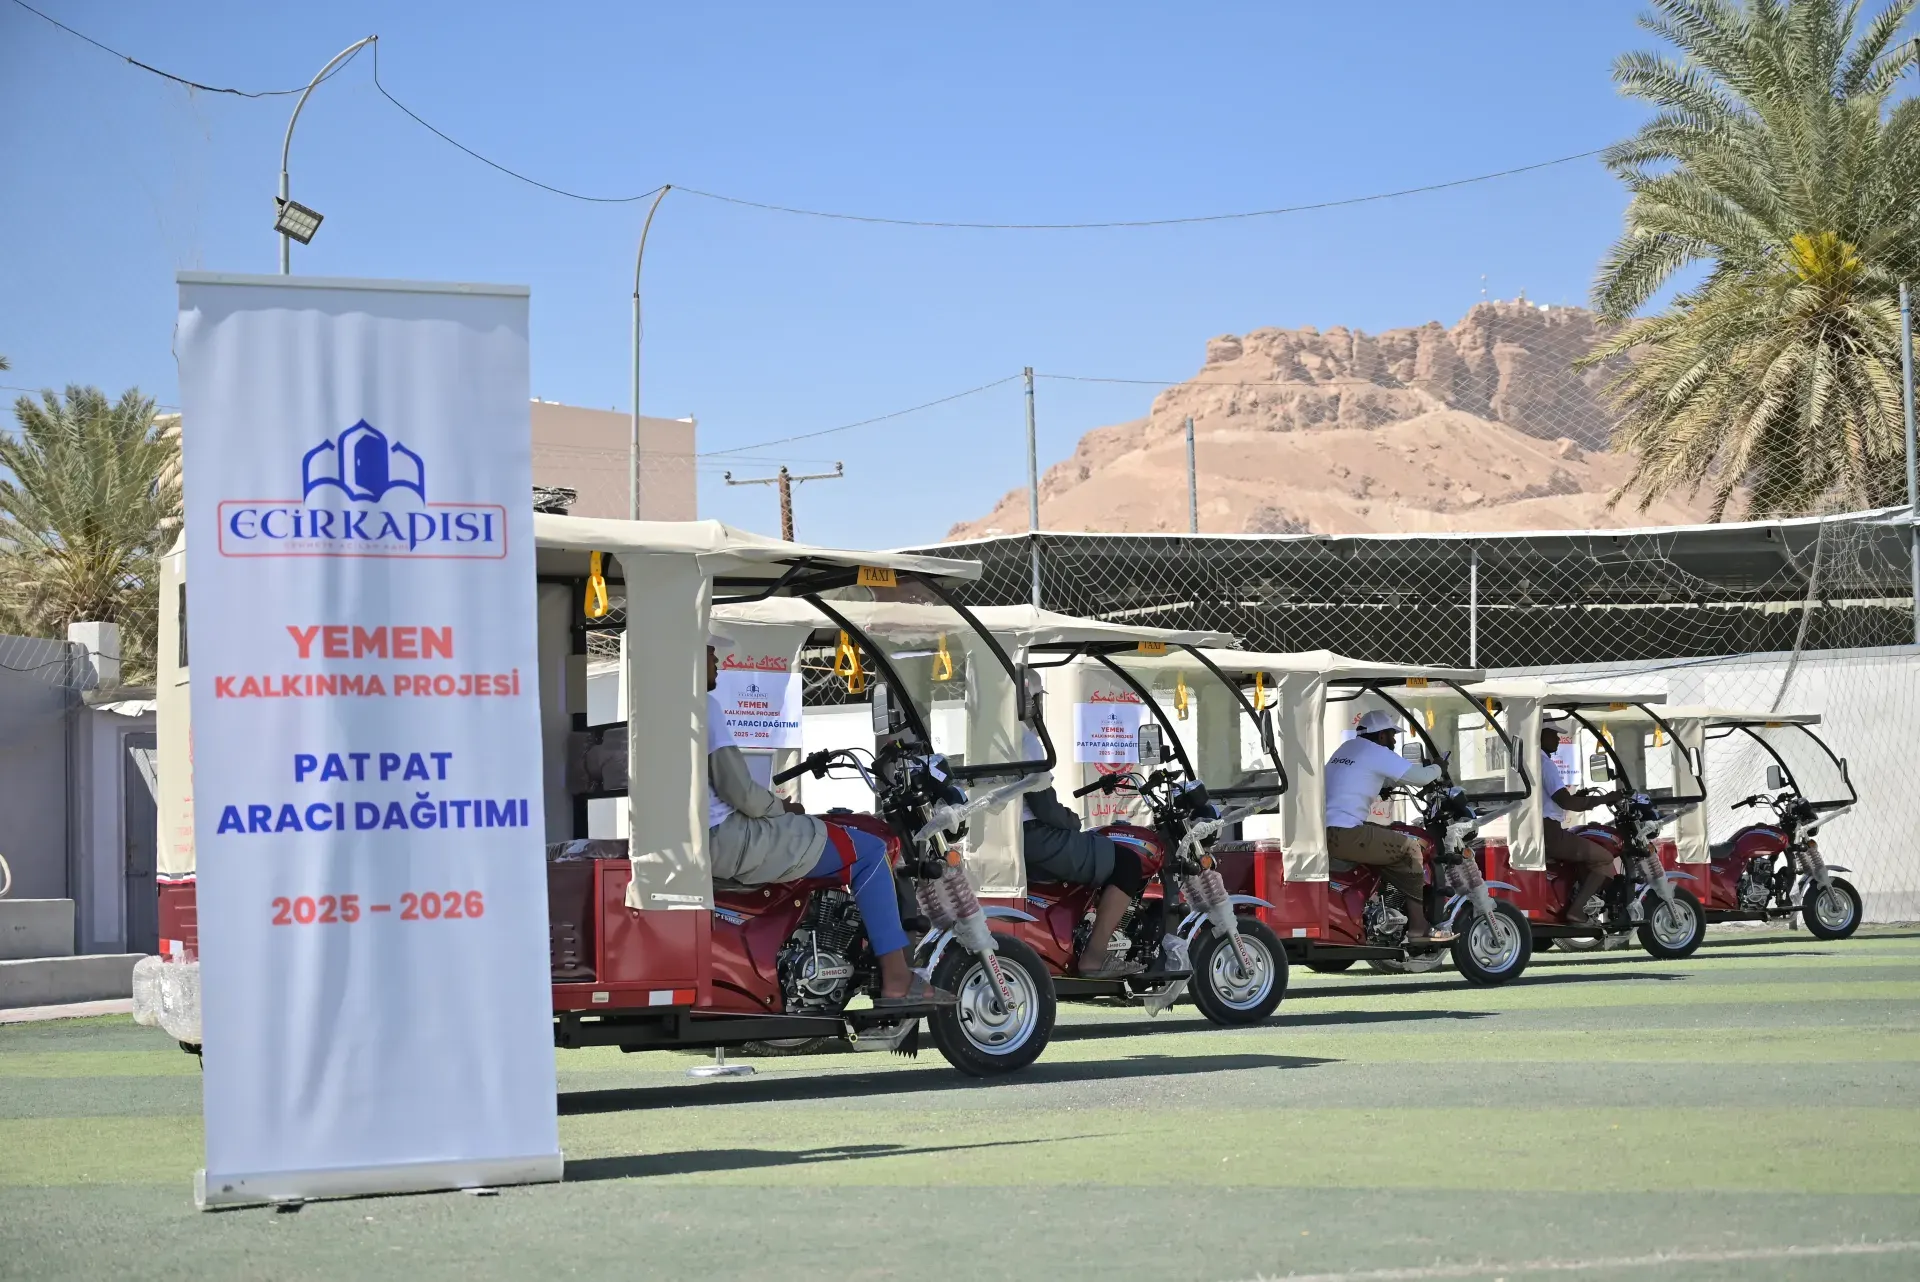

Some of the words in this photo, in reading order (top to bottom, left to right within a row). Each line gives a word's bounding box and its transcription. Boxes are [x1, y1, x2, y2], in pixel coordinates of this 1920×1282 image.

[863, 568, 889, 582] TAXI
[286, 625, 454, 660] YEMEN
[215, 674, 386, 698] KALKINMA
[394, 669, 520, 697] PROJESİ
[737, 700, 768, 709] YEMEN
[737, 720, 762, 728] ARACI
[762, 719, 799, 728] DAĞITIMI
[1120, 740, 1138, 748] DAĞIT
[295, 752, 371, 782] PAT
[379, 752, 453, 781] PAT
[217, 801, 345, 834] ARACI
[355, 791, 529, 832] DAĞITIMI
[271, 894, 361, 926] 2025
[400, 890, 485, 921] 2026
[821, 968, 848, 977] SHMCO
